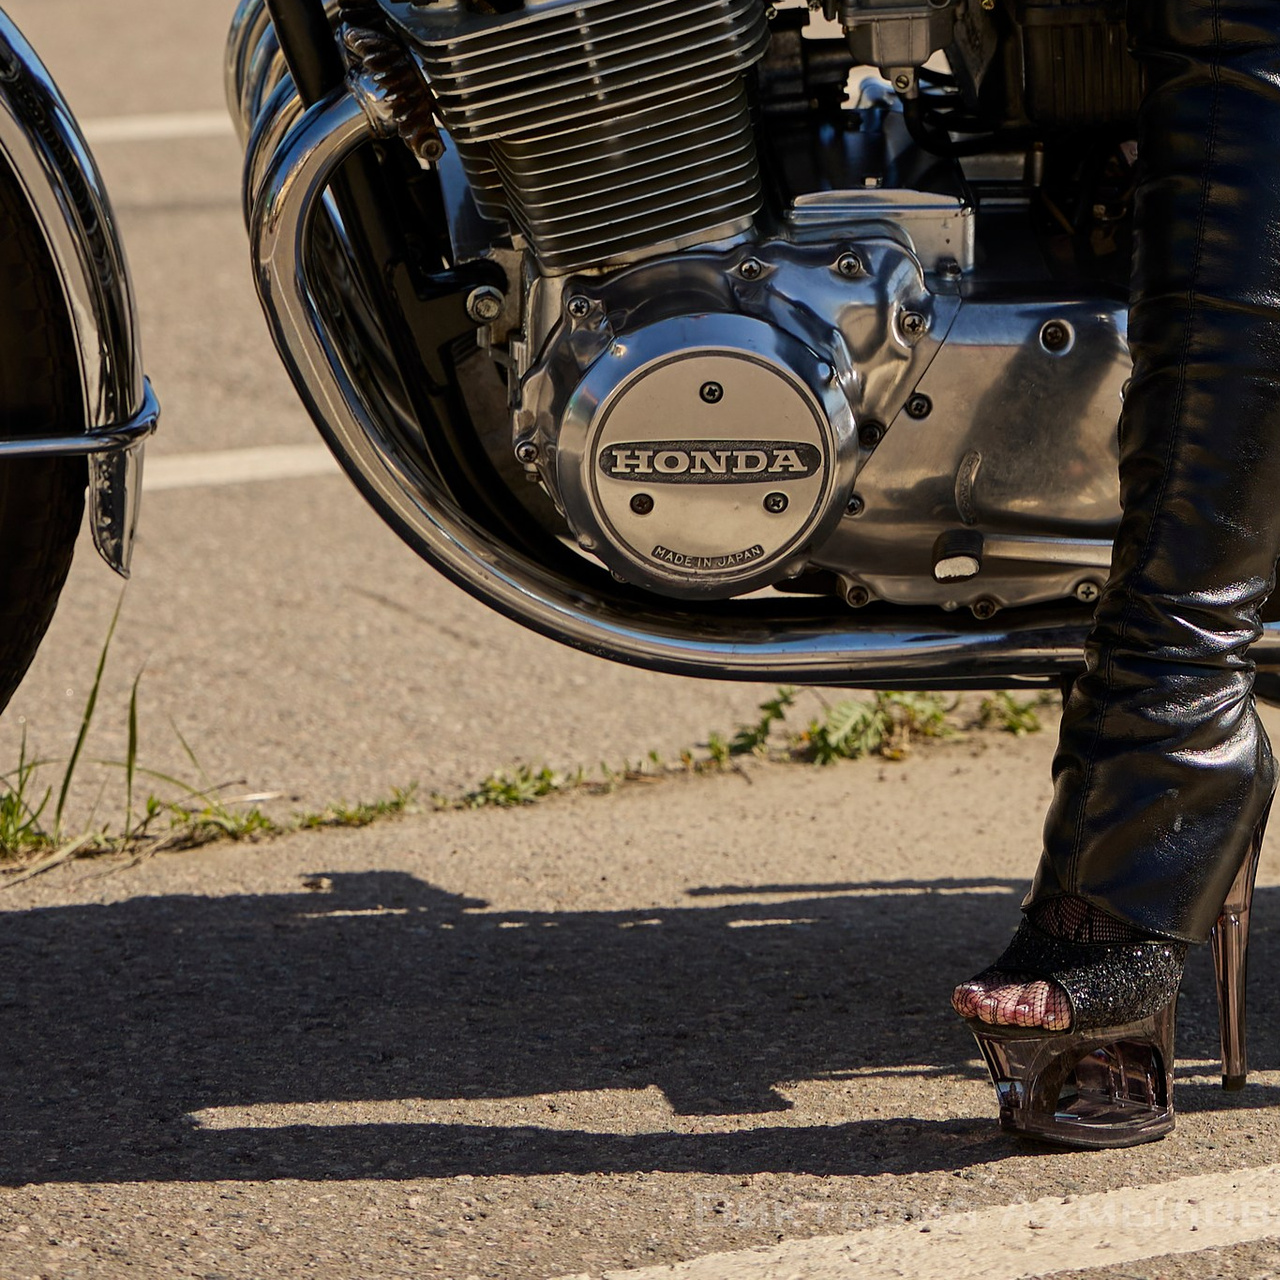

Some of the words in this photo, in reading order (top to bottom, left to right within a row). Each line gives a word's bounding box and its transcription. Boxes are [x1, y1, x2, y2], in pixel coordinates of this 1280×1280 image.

[611, 449, 808, 474] HONDA
[654, 546, 692, 567] MADE
[697, 558, 711, 568] IN
[717, 546, 761, 567] JAPAN
